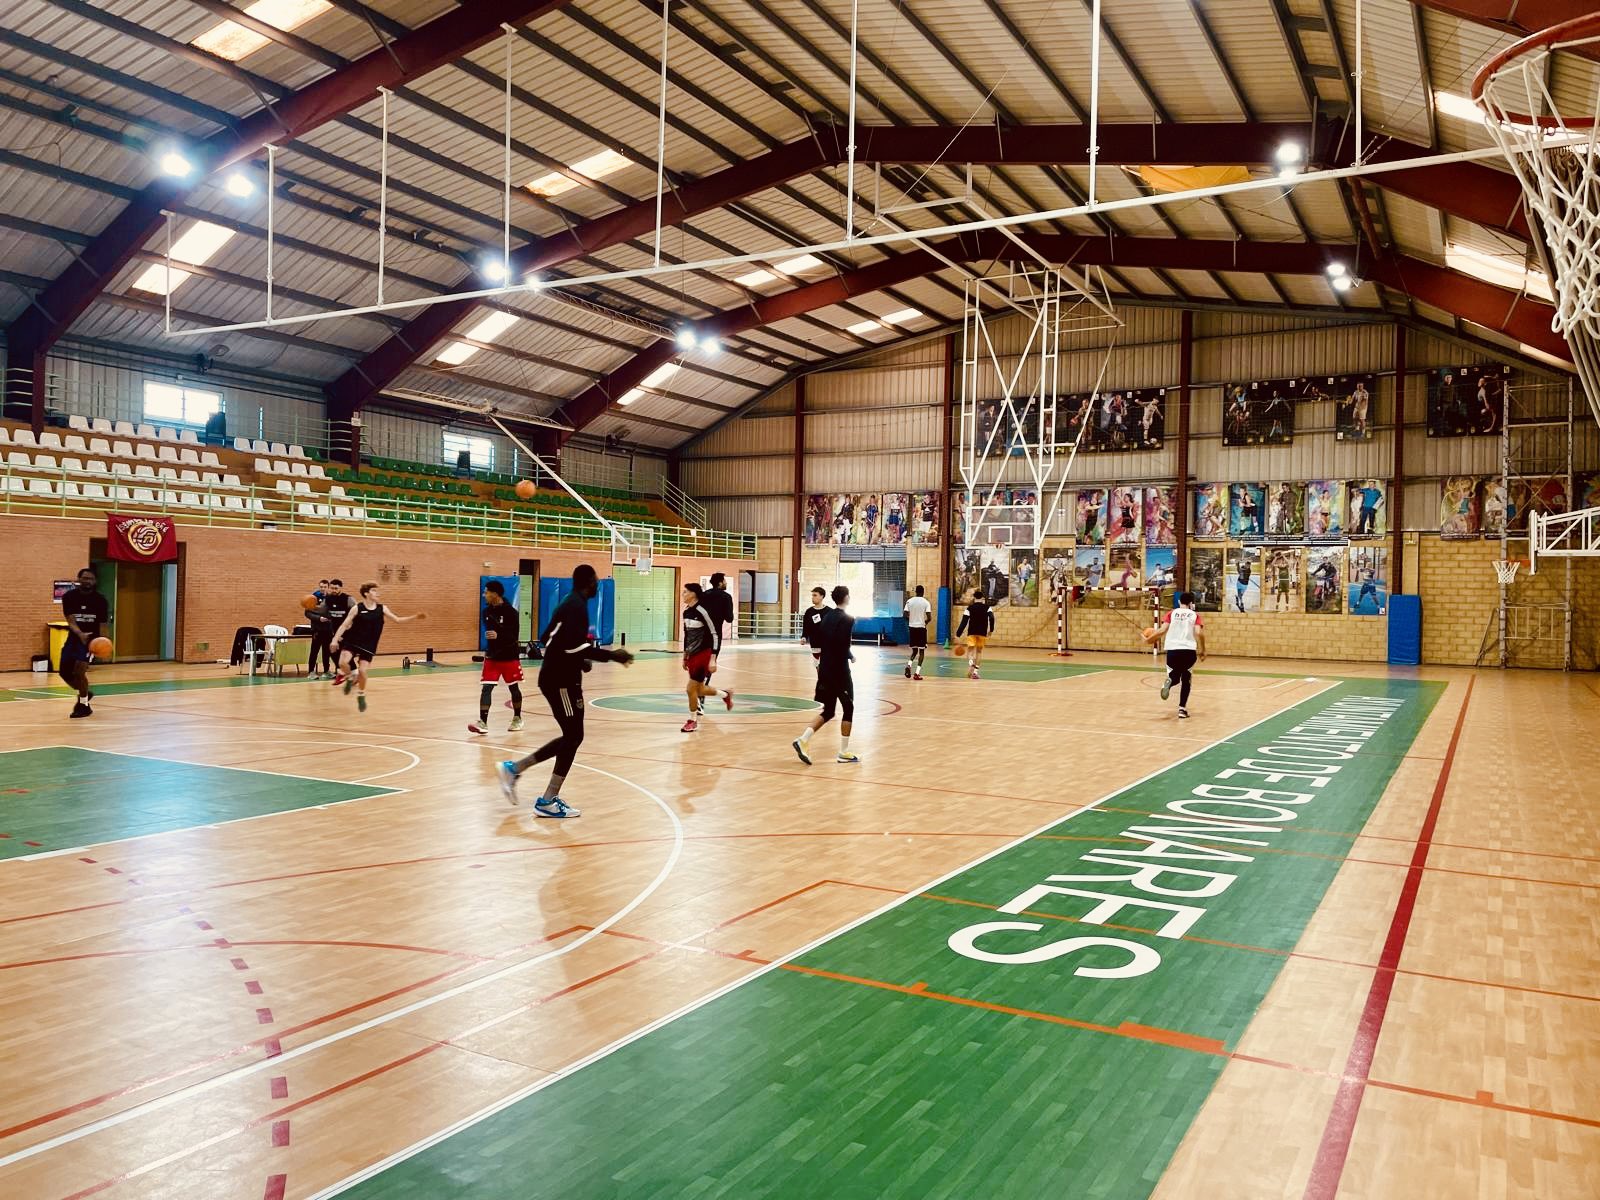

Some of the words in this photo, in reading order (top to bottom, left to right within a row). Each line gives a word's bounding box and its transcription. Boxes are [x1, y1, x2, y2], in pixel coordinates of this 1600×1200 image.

[1257, 695, 1405, 760] AYUNTAMIENTO
[1215, 758, 1342, 788] DE
[947, 784, 1315, 979] BONARES
